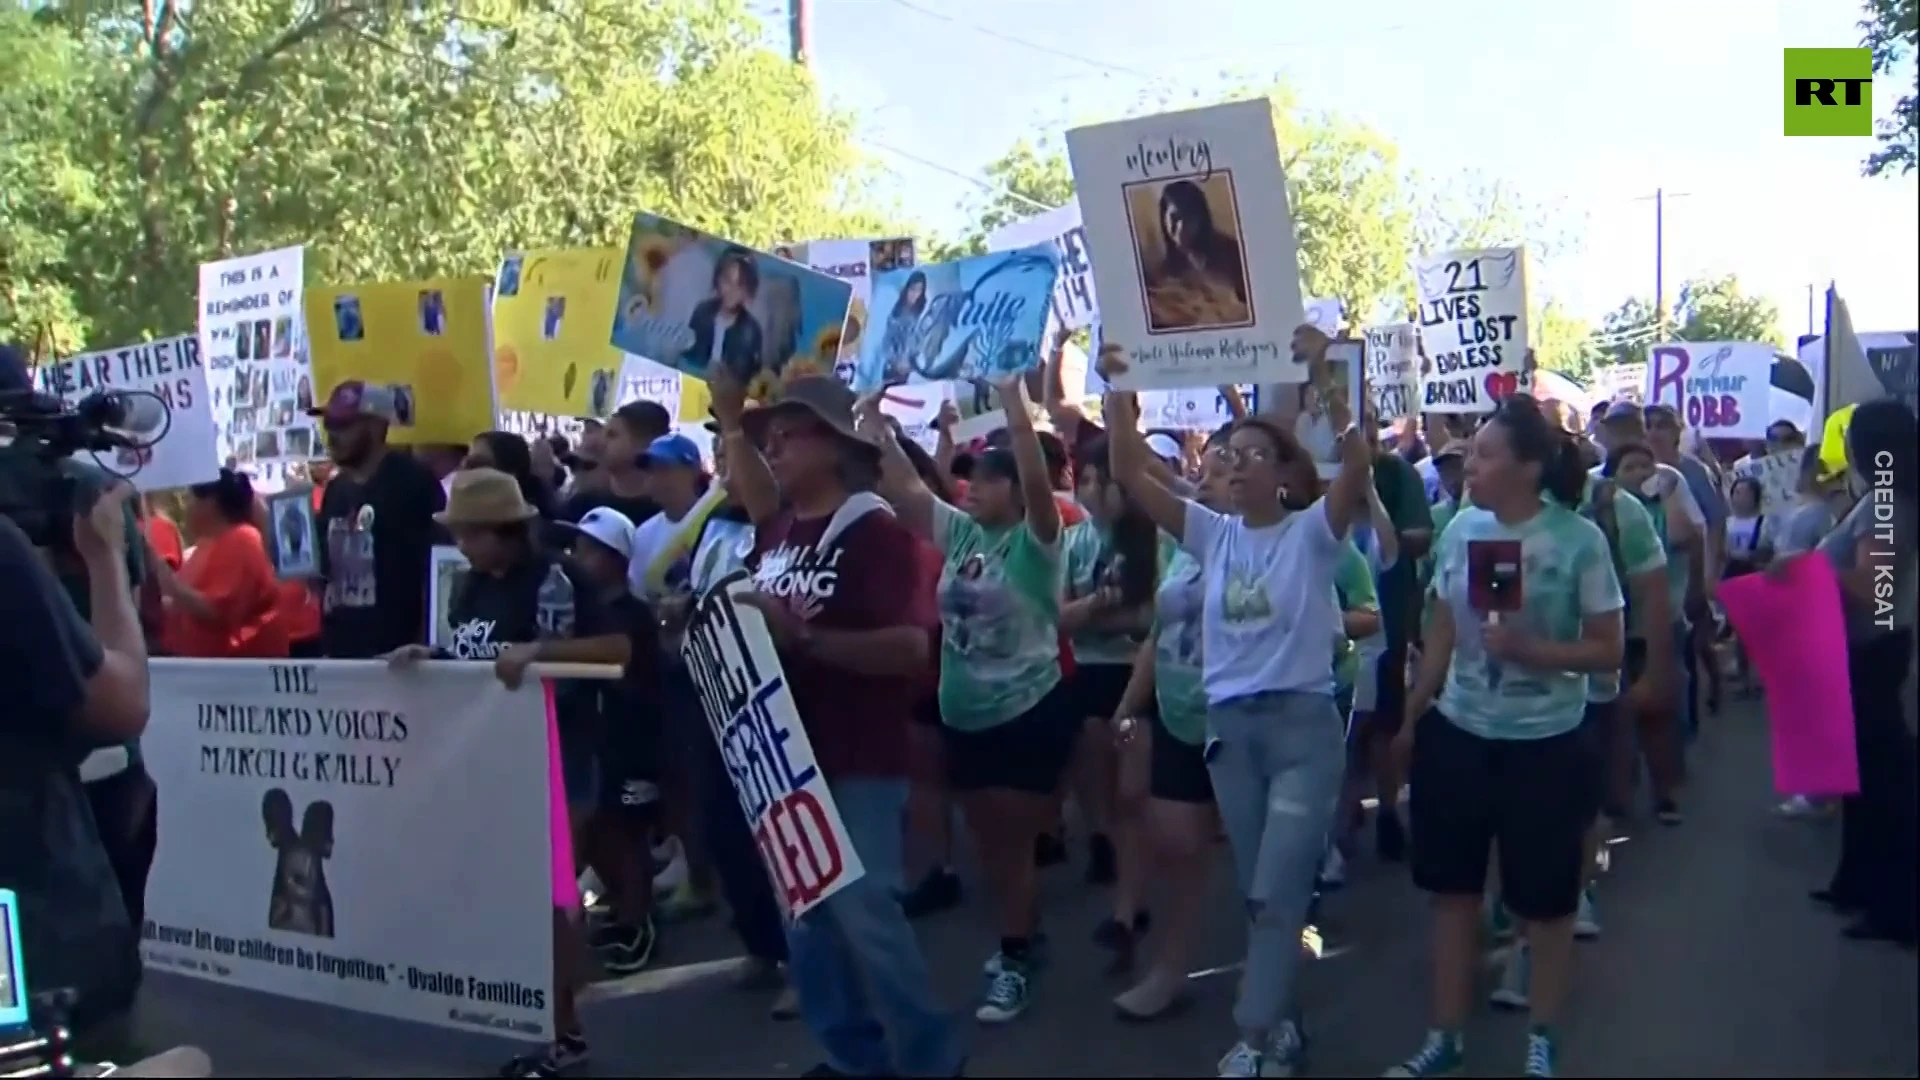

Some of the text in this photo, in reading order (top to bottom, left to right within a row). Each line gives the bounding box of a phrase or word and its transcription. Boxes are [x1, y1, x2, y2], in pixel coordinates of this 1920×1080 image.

[220, 264, 280, 288] THIS IS A
[1444, 258, 1488, 294] 21
[206, 290, 295, 316] REMINDER OF
[1419, 294, 1482, 327] LIVES
[1458, 315, 1517, 346] LOST
[41, 337, 202, 395] HEAR THEIR
[268, 664, 318, 694] THE
[198, 703, 408, 742] UNHEARD VOICES
[200, 744, 286, 779] MARCH
[315, 753, 401, 787] RALLY
[214, 935, 236, 954] our
[238, 938, 295, 966] children
[296, 946, 315, 971] be
[407, 965, 465, 997] Uvalde
[468, 975, 546, 1010] Families
